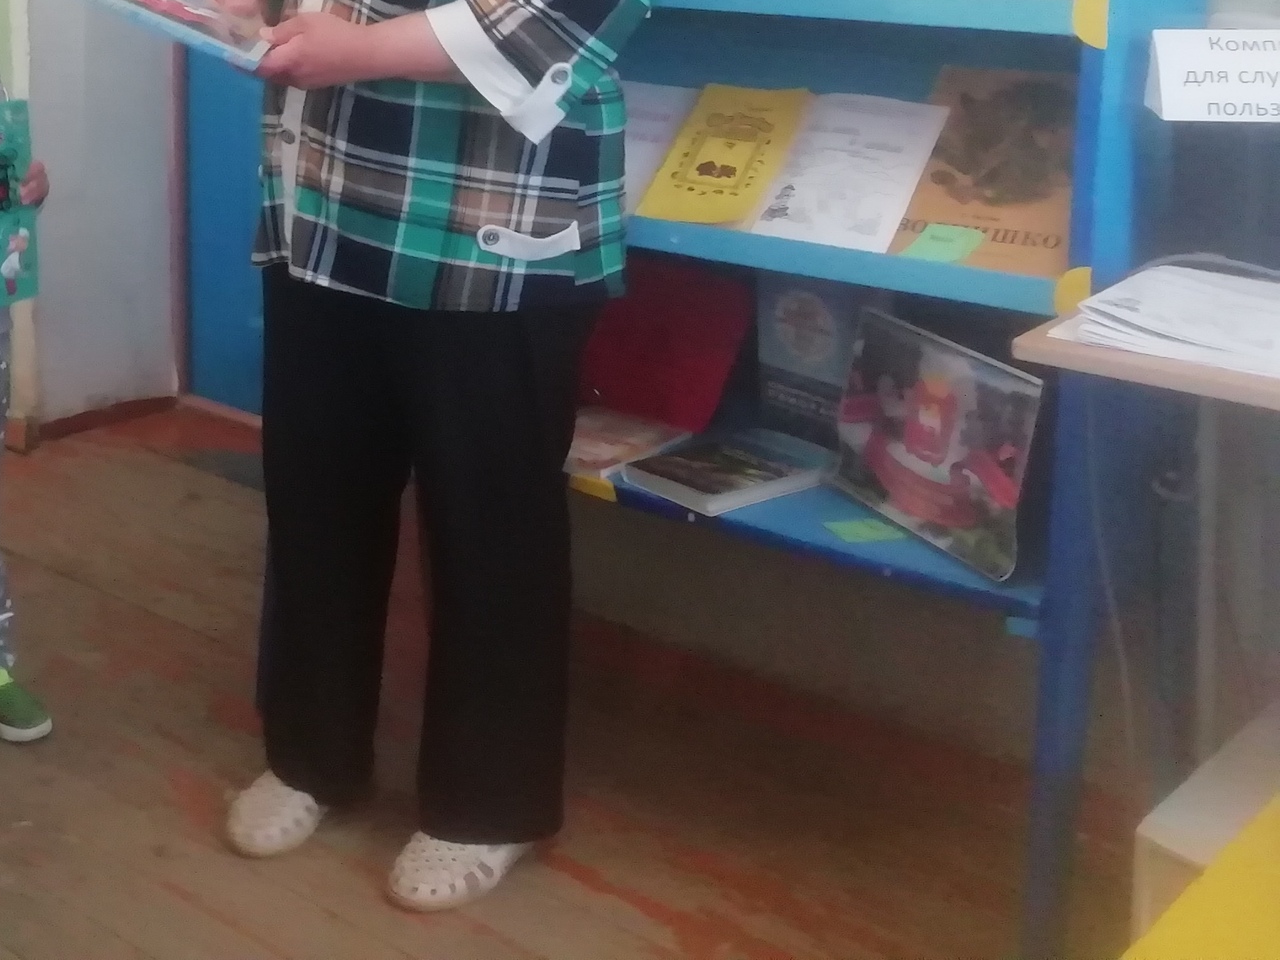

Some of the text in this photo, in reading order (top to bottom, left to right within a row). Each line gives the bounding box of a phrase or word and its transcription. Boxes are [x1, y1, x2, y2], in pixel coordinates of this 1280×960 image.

[1209, 36, 1280, 52] Комп
[1183, 70, 1279, 88] для слу
[1207, 102, 1280, 117] польз
